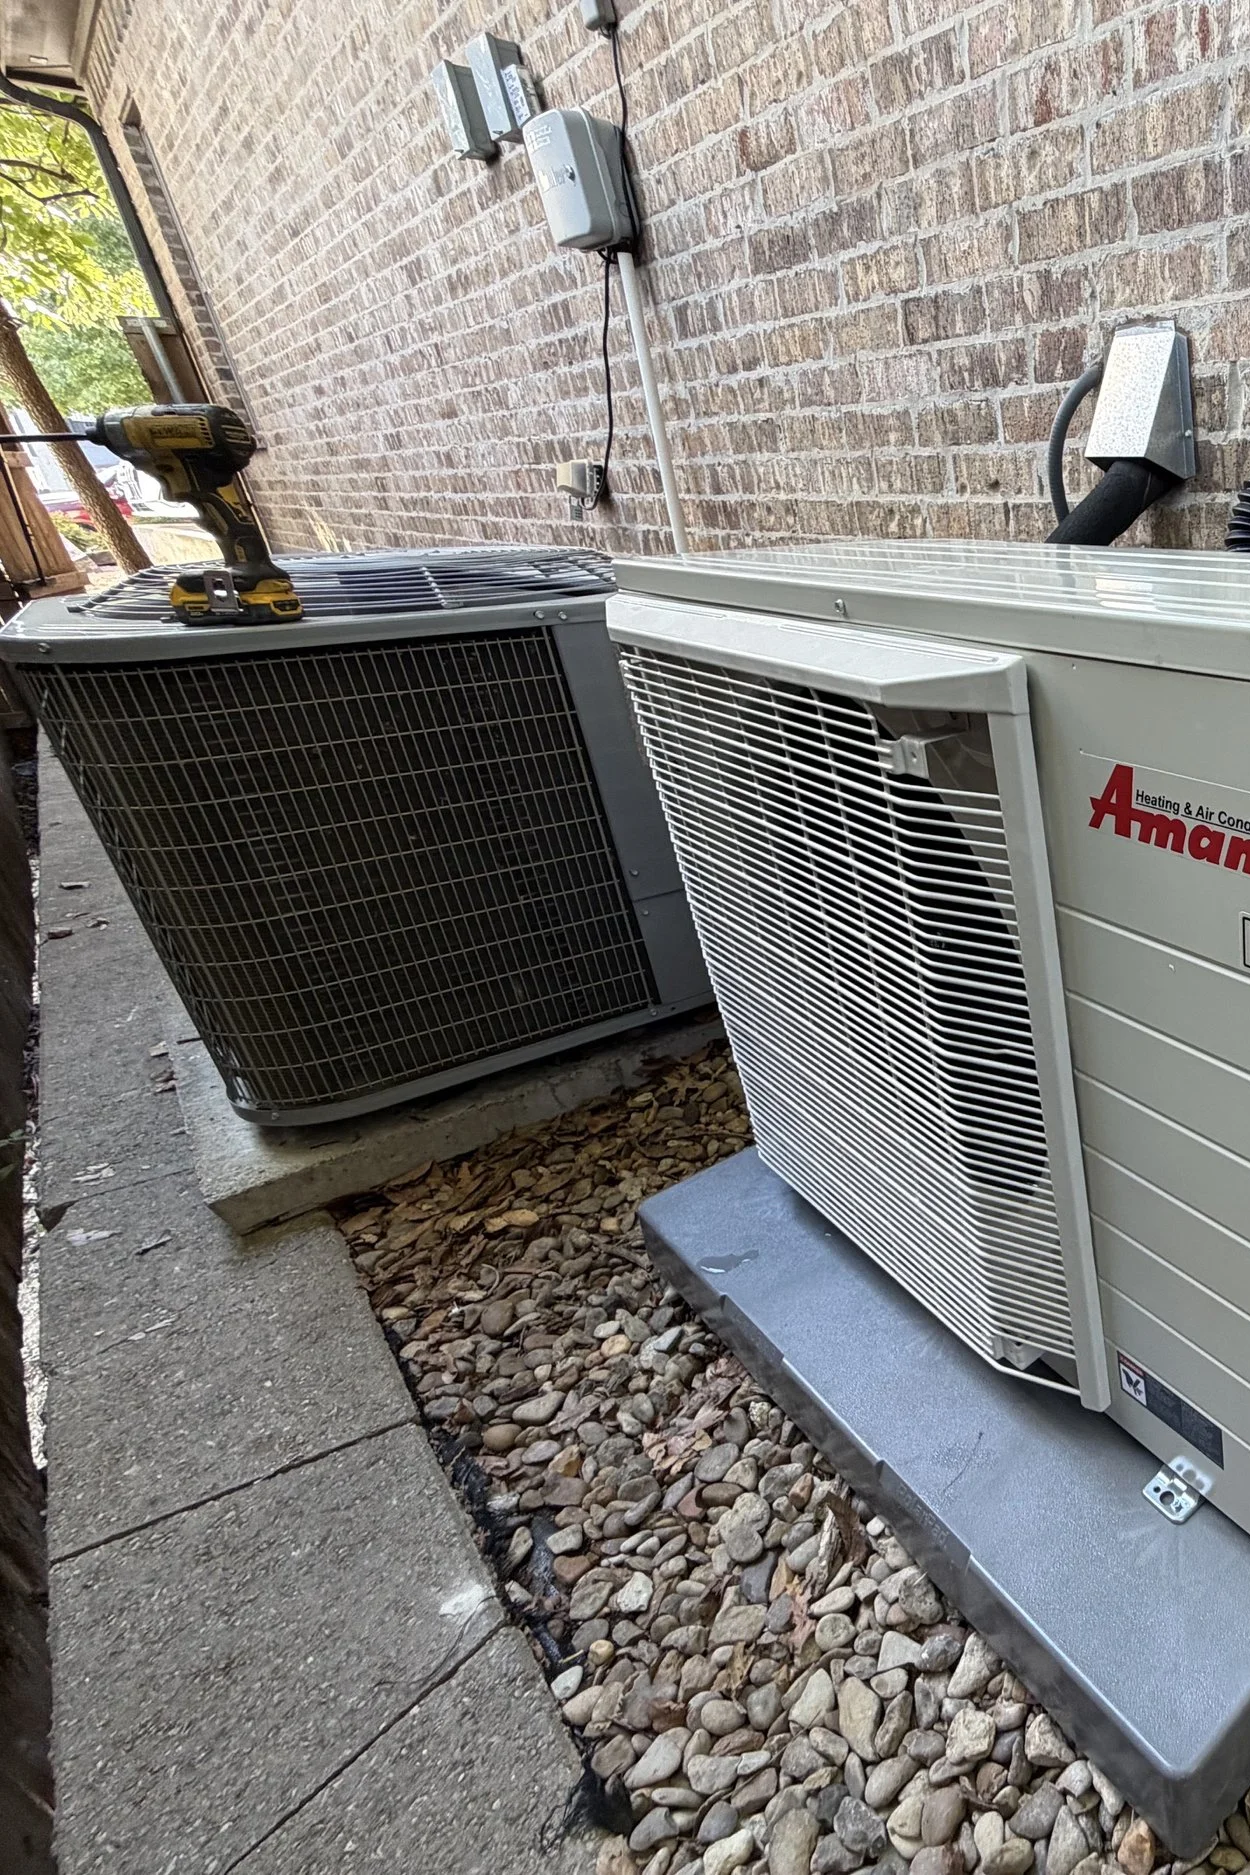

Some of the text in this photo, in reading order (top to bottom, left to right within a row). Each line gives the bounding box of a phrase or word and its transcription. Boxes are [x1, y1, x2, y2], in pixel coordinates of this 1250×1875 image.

[1135, 789, 1180, 815] Heating
[1183, 802, 1193, 816] &
[1195, 804, 1214, 822] Air
